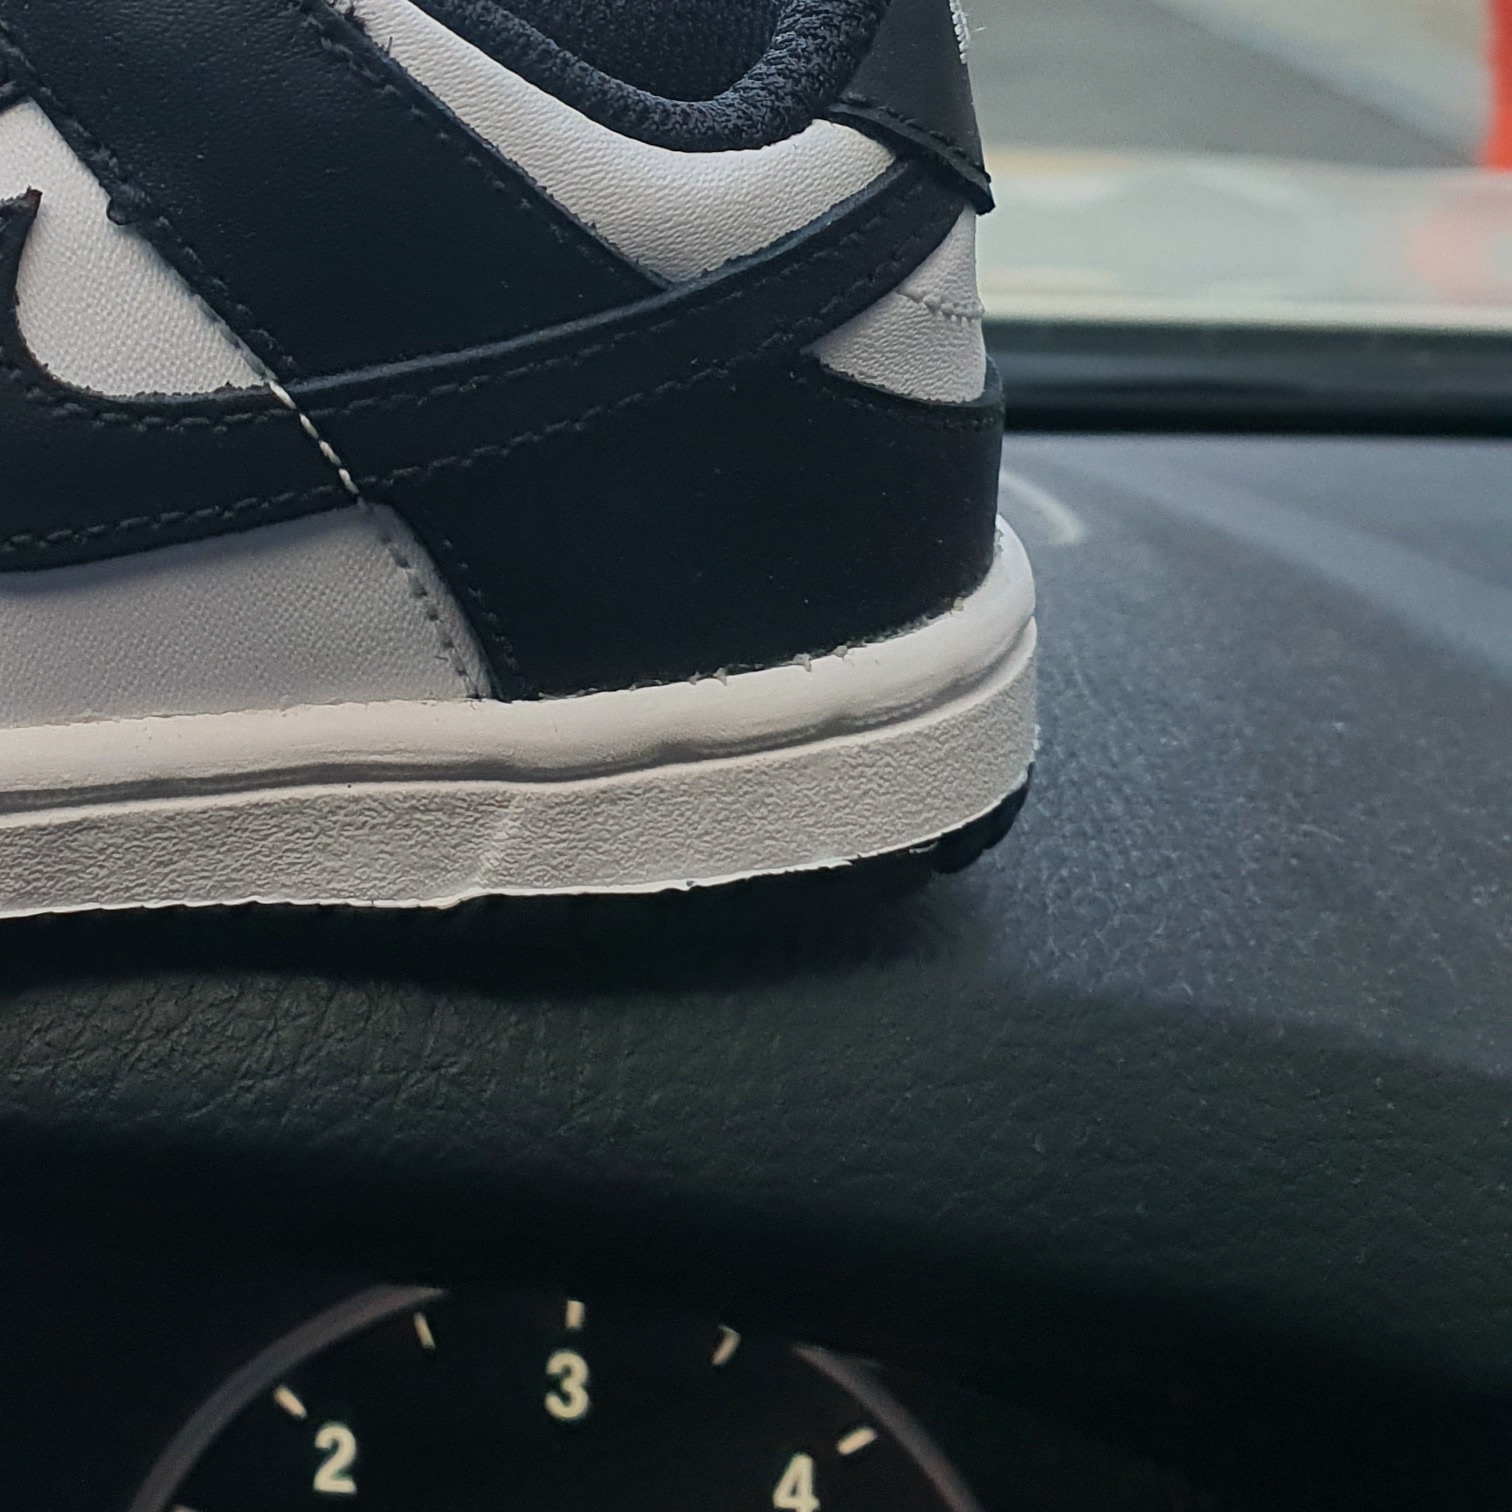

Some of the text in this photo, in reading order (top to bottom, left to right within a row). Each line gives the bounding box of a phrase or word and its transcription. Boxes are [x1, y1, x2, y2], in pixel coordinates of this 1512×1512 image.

[544, 1351, 590, 1420] 3
[312, 1423, 357, 1494] 2
[772, 1453, 821, 1512] 4
